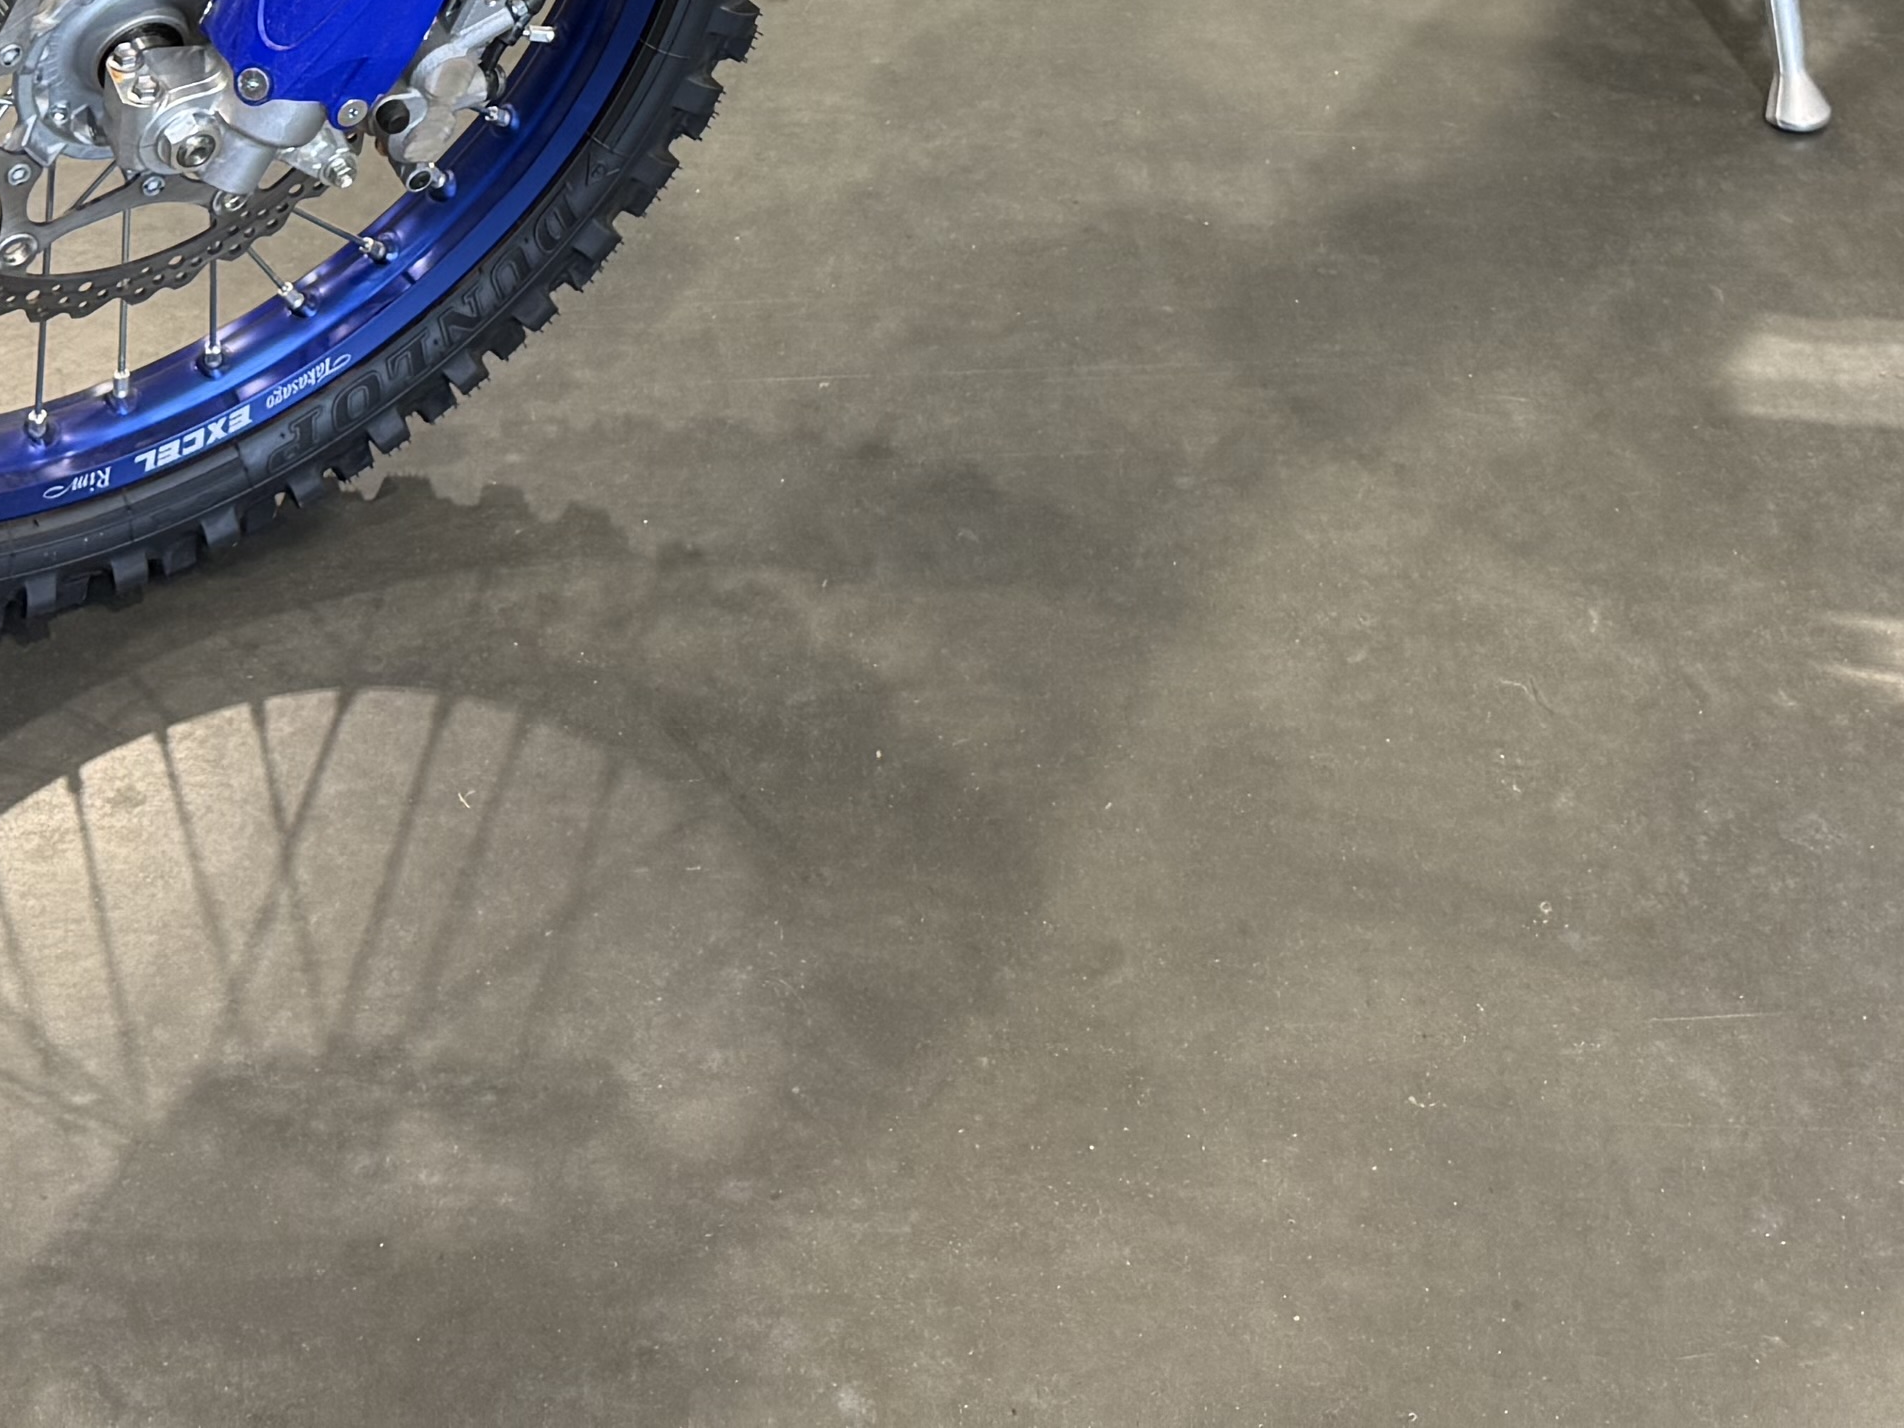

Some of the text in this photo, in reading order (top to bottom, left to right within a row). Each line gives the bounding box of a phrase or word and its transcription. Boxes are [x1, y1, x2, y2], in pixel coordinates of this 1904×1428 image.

[54, 353, 352, 499] Takasago EXCEL Rim
[266, 180, 579, 477] DUNLOP
